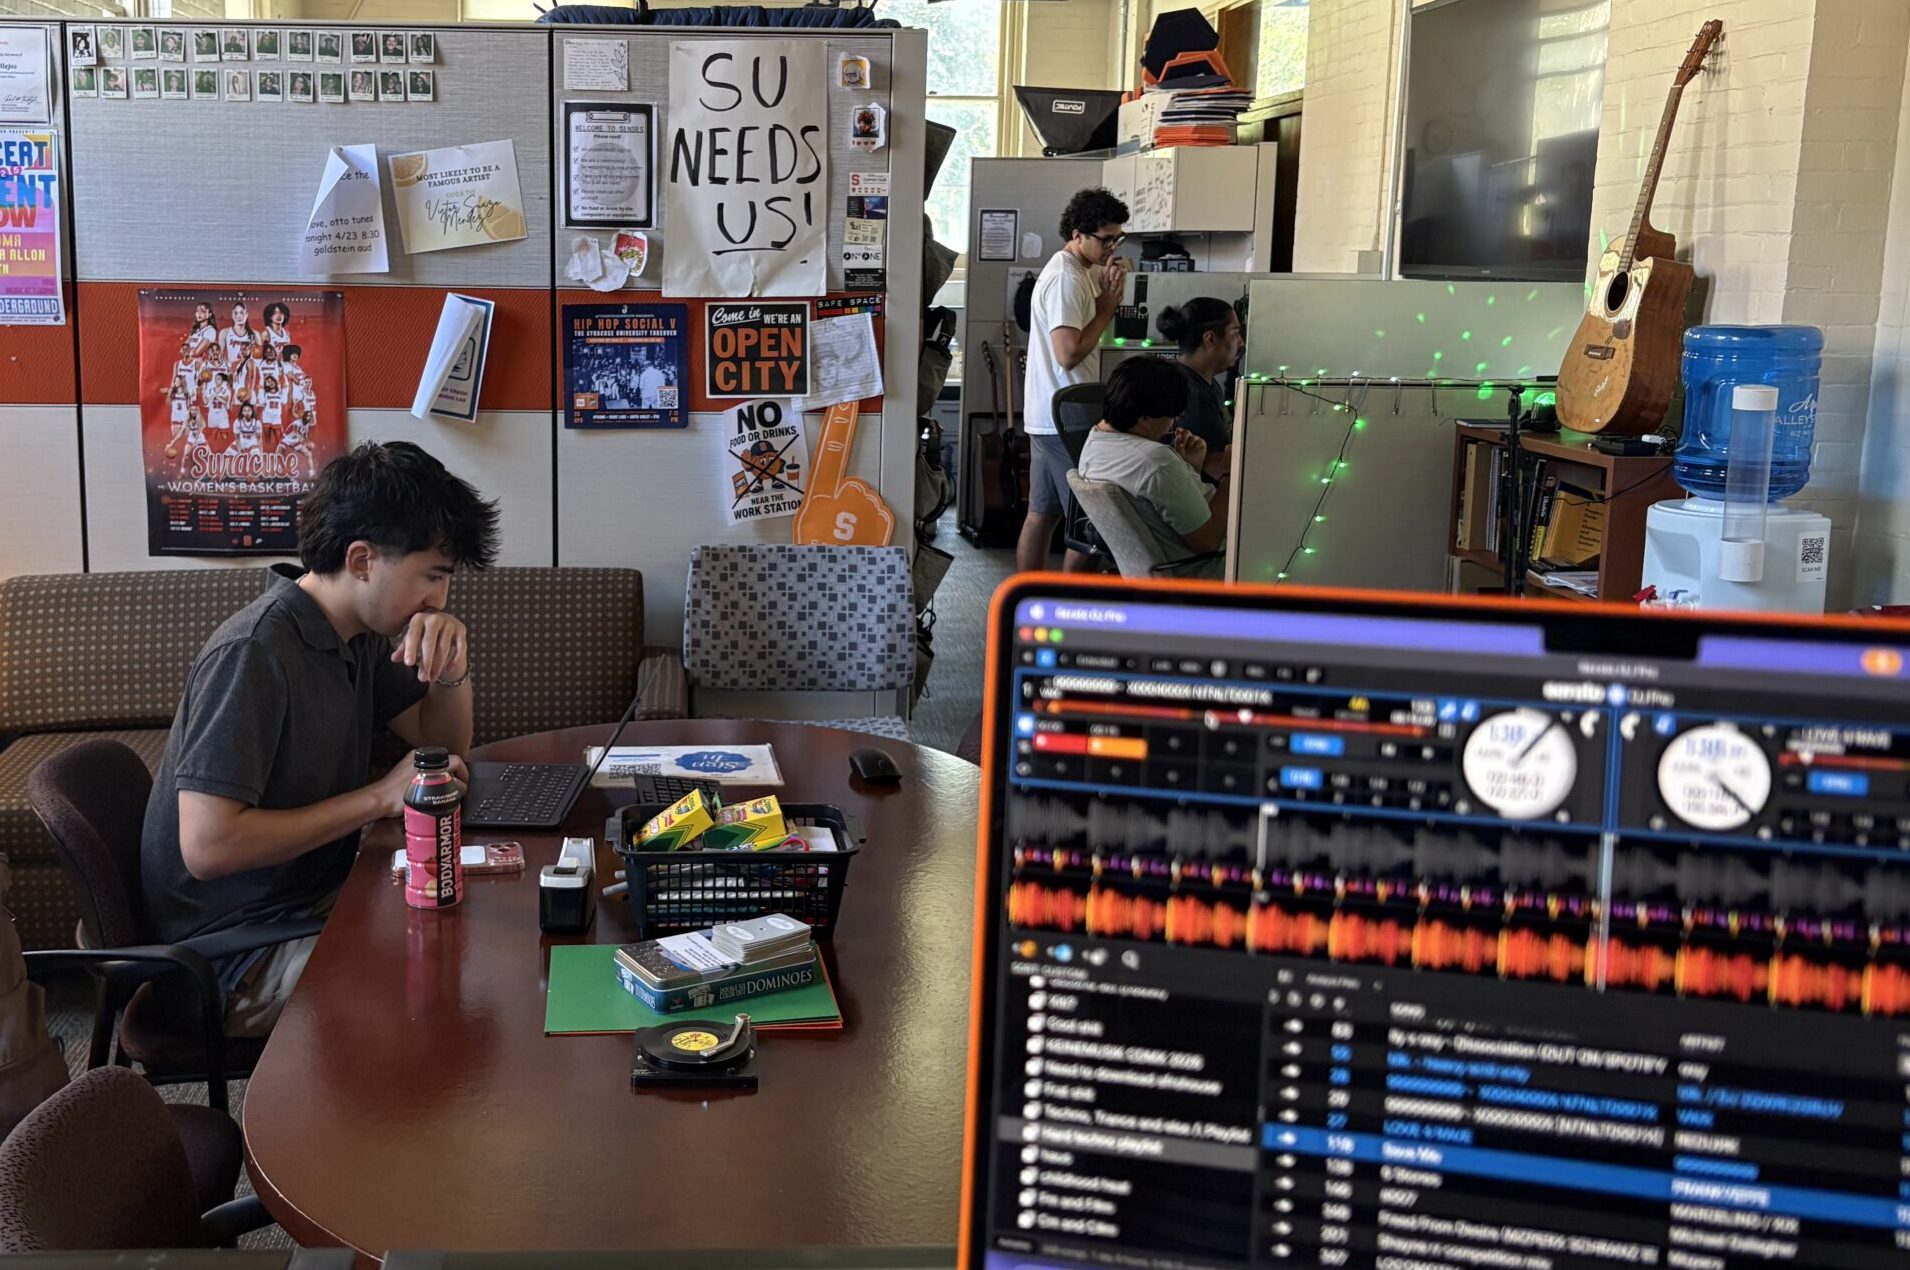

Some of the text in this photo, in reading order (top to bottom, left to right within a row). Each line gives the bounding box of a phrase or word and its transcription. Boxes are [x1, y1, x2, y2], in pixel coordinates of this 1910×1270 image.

[699, 52, 787, 111] SU
[670, 123, 821, 186] NEEDS
[355, 170, 370, 180] the
[416, 164, 501, 183] MOST LIKELY TO BE A
[428, 173, 491, 189] FAMOUS ARTIST
[330, 216, 349, 227] otto
[352, 214, 375, 226] tunes
[716, 191, 813, 263] US!
[0, 234, 21, 247] MA
[335, 230, 358, 241] 4/23
[361, 228, 380, 240] 8:30
[10, 249, 46, 261] ALLON
[314, 243, 372, 258] goldstein aud
[817, 296, 881, 309] SAFE SPACE
[574, 318, 677, 331] HIP HOP SOCIAL V
[712, 306, 802, 325] Come in WE'RE AN
[713, 327, 802, 358] OPEN
[715, 360, 801, 391] CITY
[737, 401, 783, 435] NO
[730, 426, 797, 449] FOOD OR DRINKS
[191, 446, 299, 479] Syracuse
[168, 481, 314, 494] WOMEN'S BASKETBA
[751, 494, 784, 505] NEAR THE
[733, 507, 762, 520] WORK
[833, 511, 857, 541] S
[440, 815, 454, 899] BODYARMOR
[747, 969, 813, 994] DOMINOES
